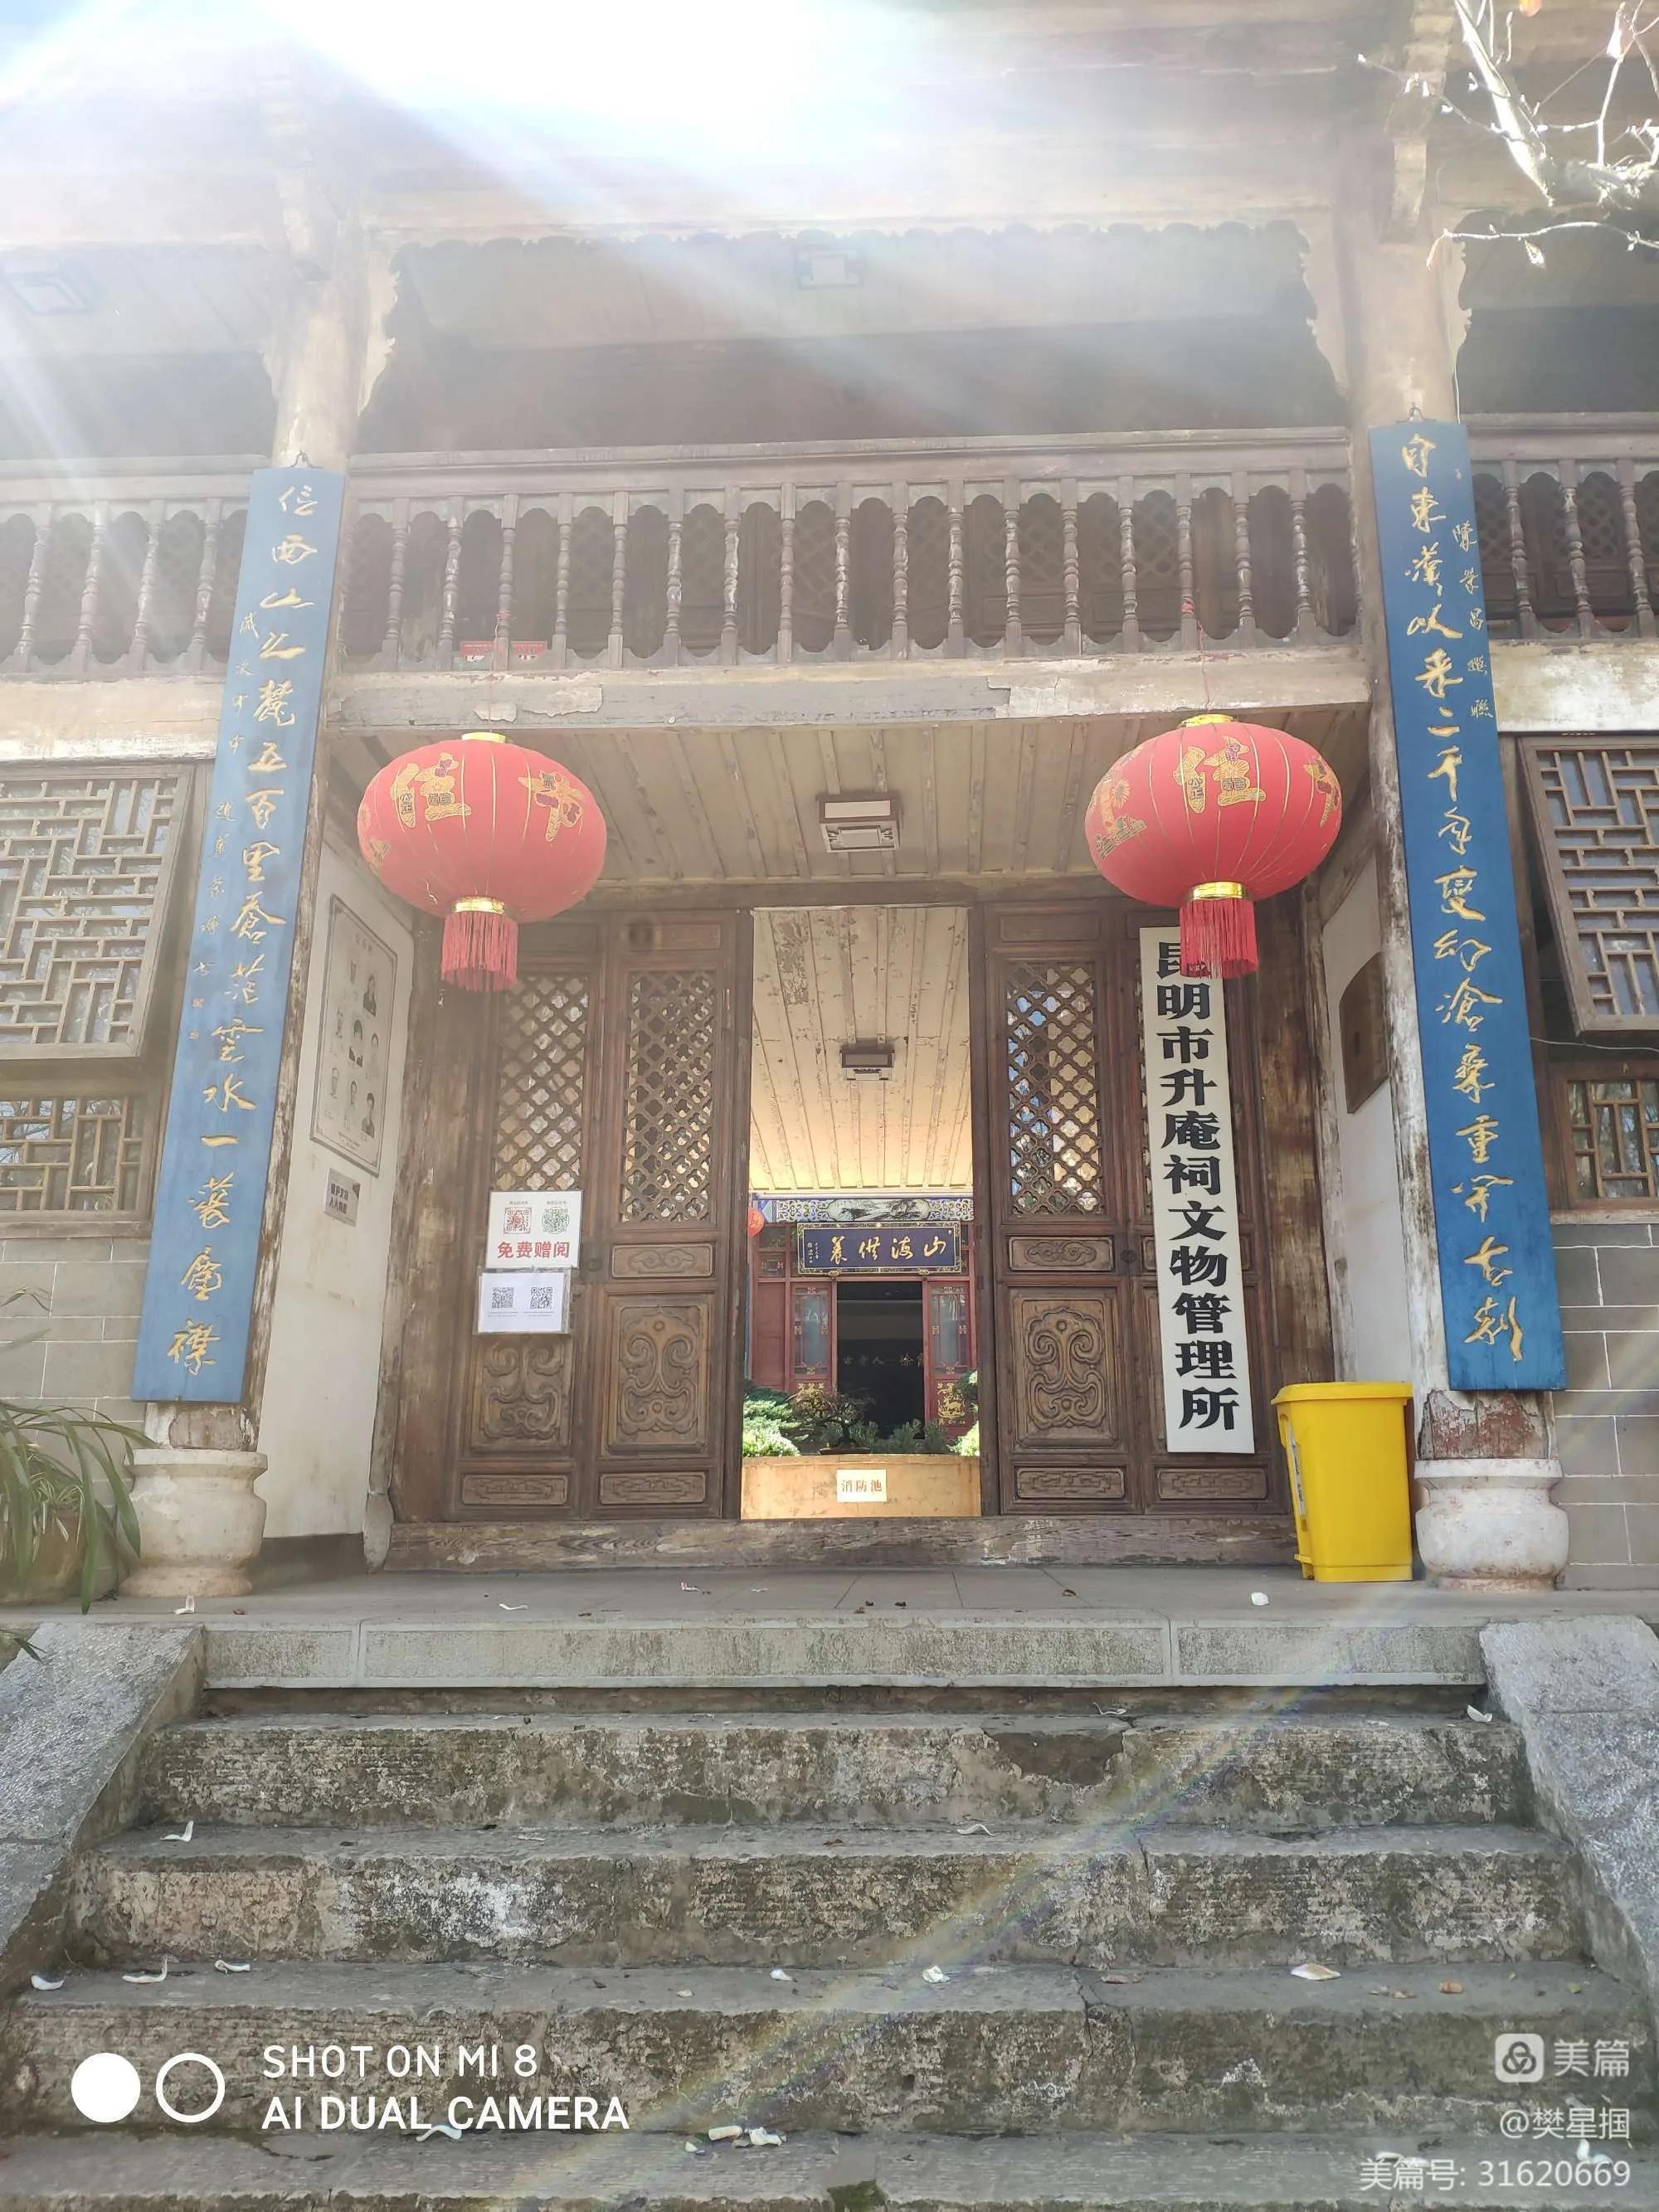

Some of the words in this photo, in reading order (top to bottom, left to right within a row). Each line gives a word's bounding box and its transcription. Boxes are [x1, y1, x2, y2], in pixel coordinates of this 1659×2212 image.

[497, 1241, 571, 1259] 免费赠阅
[840, 1479, 883, 1494] 消防池
